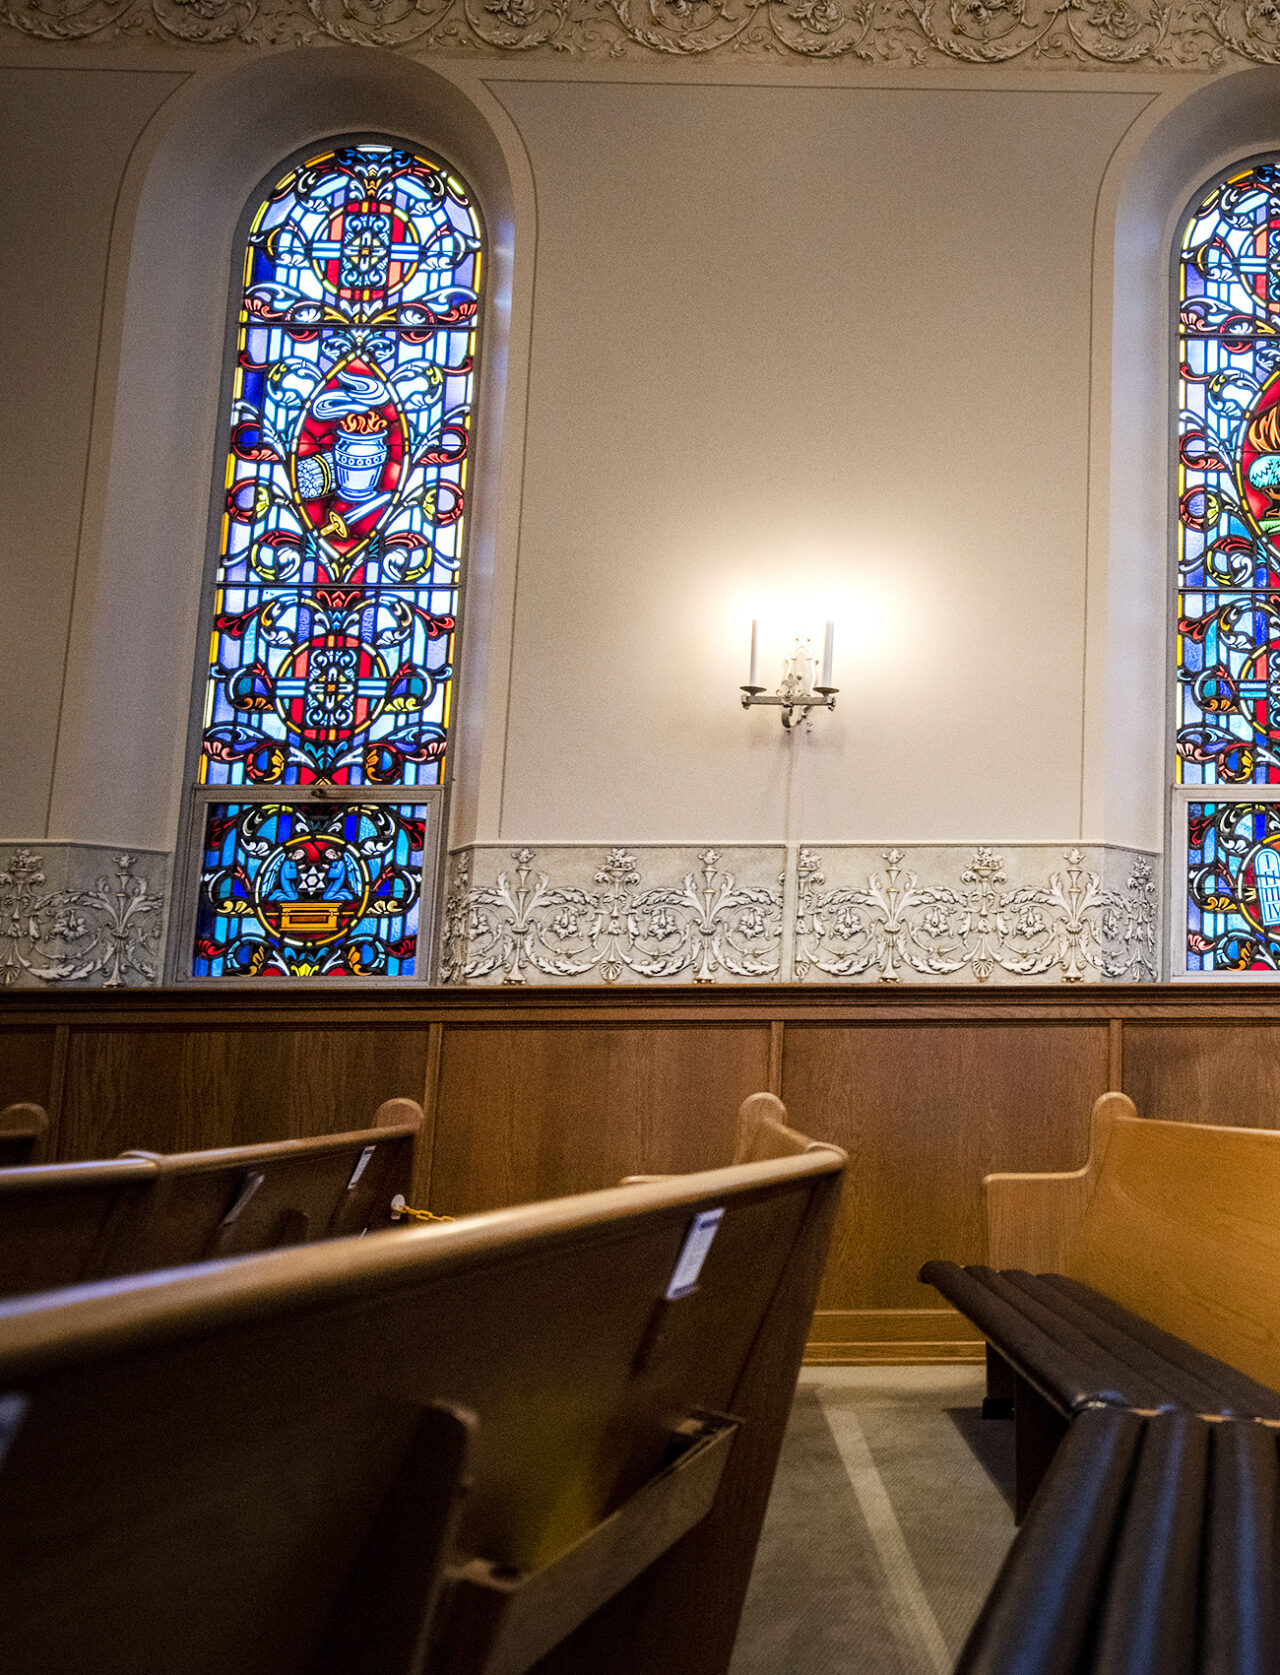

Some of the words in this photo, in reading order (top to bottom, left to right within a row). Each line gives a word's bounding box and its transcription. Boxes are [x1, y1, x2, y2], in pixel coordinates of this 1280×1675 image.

[1265, 854, 1271, 869] I
[1264, 870, 1277, 885] II
[1264, 886, 1280, 903] III
